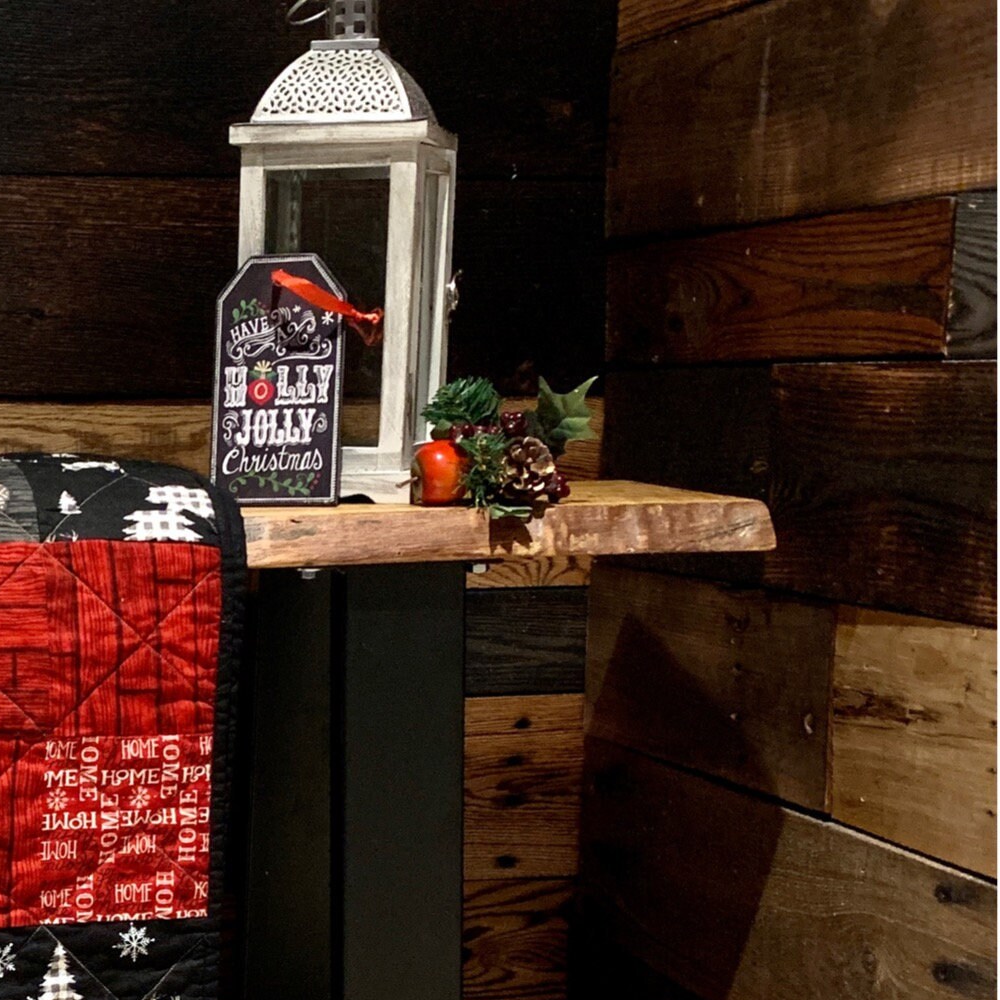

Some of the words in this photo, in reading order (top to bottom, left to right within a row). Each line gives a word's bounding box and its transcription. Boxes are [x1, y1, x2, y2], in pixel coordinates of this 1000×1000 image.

[230, 315, 270, 344] HAVE
[275, 327, 288, 342] A
[224, 364, 333, 407] HOLLY
[235, 408, 316, 447] JOLLY
[221, 447, 323, 475] Christmas
[122, 738, 160, 760] HOME
[178, 790, 198, 862] HOME
[115, 883, 153, 903] HOME
